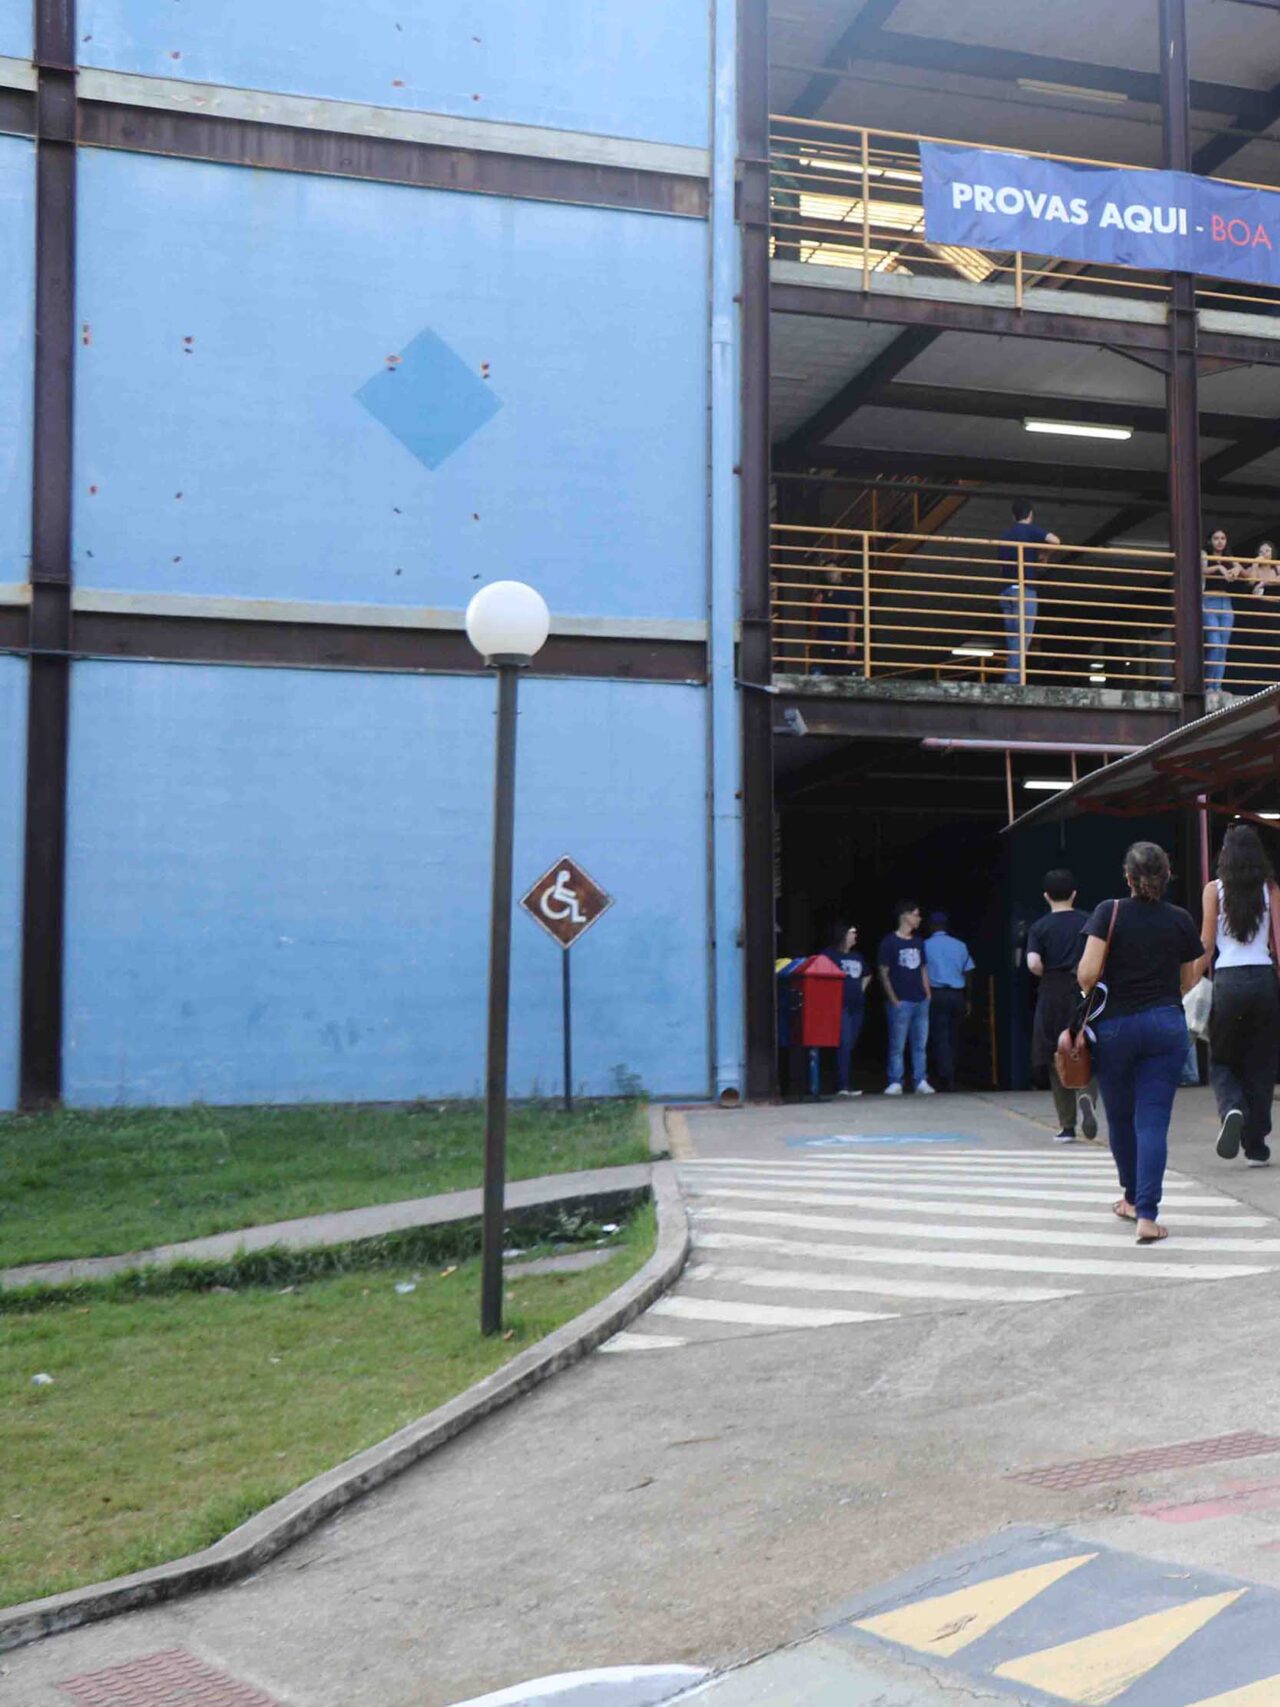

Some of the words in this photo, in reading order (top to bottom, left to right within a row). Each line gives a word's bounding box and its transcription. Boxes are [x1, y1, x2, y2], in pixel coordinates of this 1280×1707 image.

[953, 182, 1089, 225] PROVAS
[1099, 202, 1188, 235] AQUI
[1212, 213, 1272, 250] BOA
